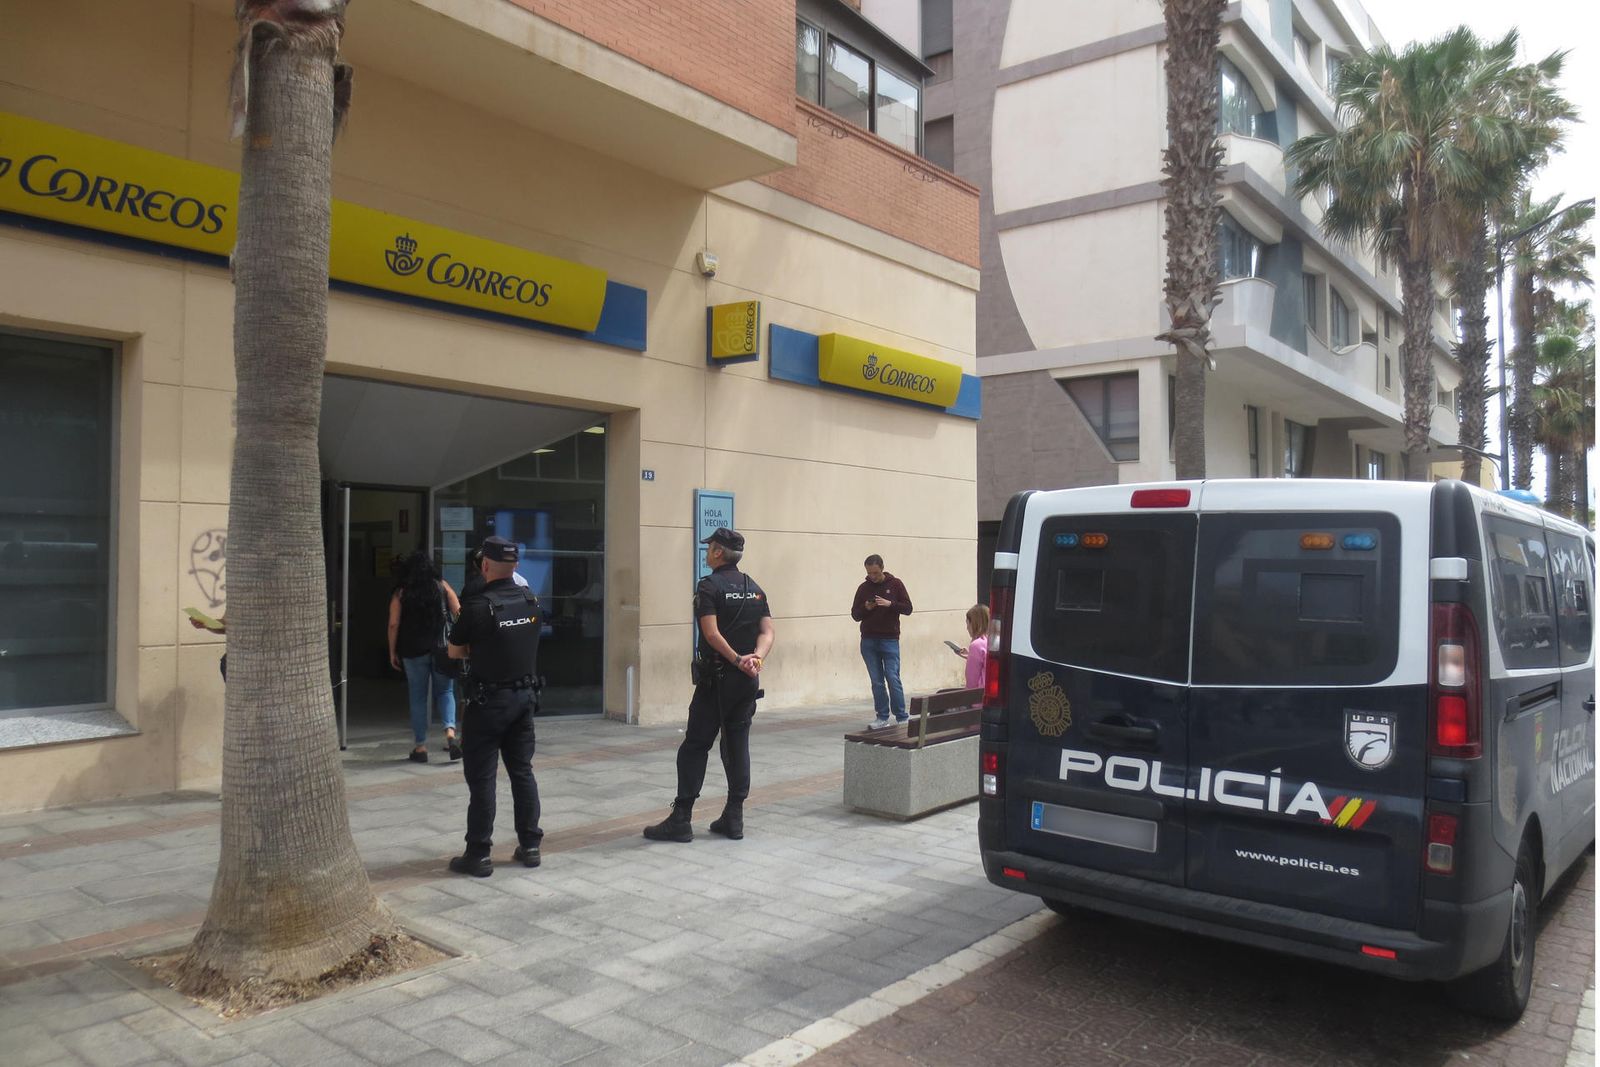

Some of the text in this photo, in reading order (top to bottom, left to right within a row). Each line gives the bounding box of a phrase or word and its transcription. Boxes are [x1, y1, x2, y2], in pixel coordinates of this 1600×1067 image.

[18, 154, 227, 234] CORREOS
[426, 253, 552, 307] CORREOS
[743, 301, 755, 352] CORREOS
[880, 363, 937, 394] CORREOS
[704, 509, 722, 518] HOLA
[704, 519, 729, 528] VECINO
[1059, 748, 1332, 820] POLICÍA
[1550, 746, 1594, 794] NACIONAL
[1235, 849, 1360, 876] www.policia.es
